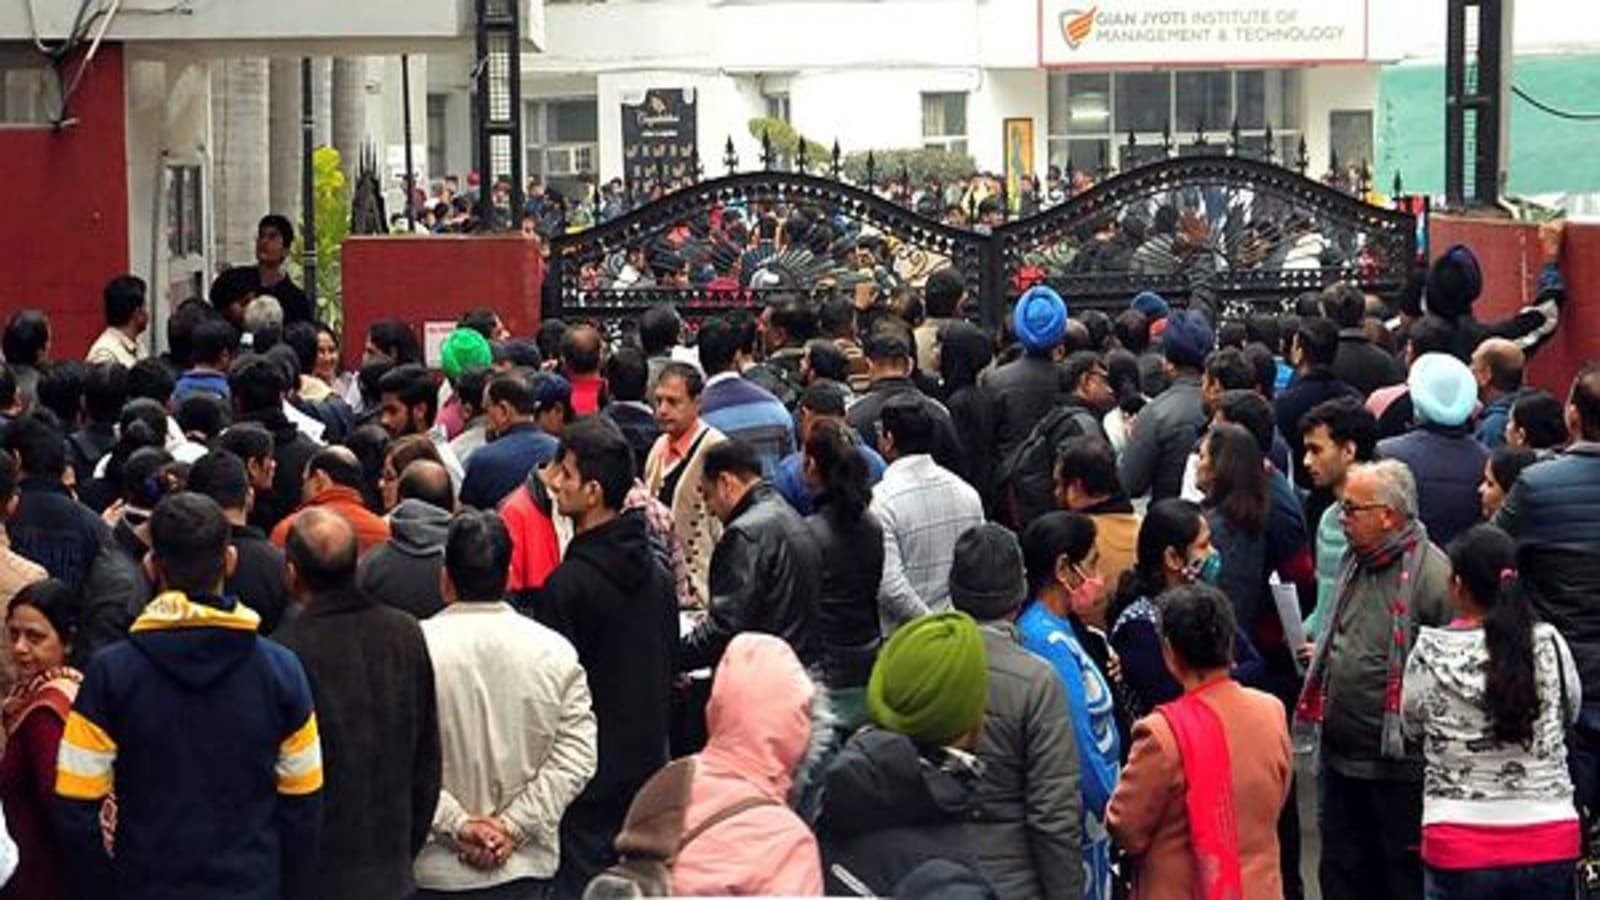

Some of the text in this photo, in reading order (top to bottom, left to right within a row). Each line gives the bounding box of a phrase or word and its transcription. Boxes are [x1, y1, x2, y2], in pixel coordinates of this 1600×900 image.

[1096, 8, 1299, 25] GIAN JYOTI INSTITUTE OF
[1096, 28, 1210, 42] MANAGEMENT
[1236, 25, 1345, 42] TECHNOLOGY
